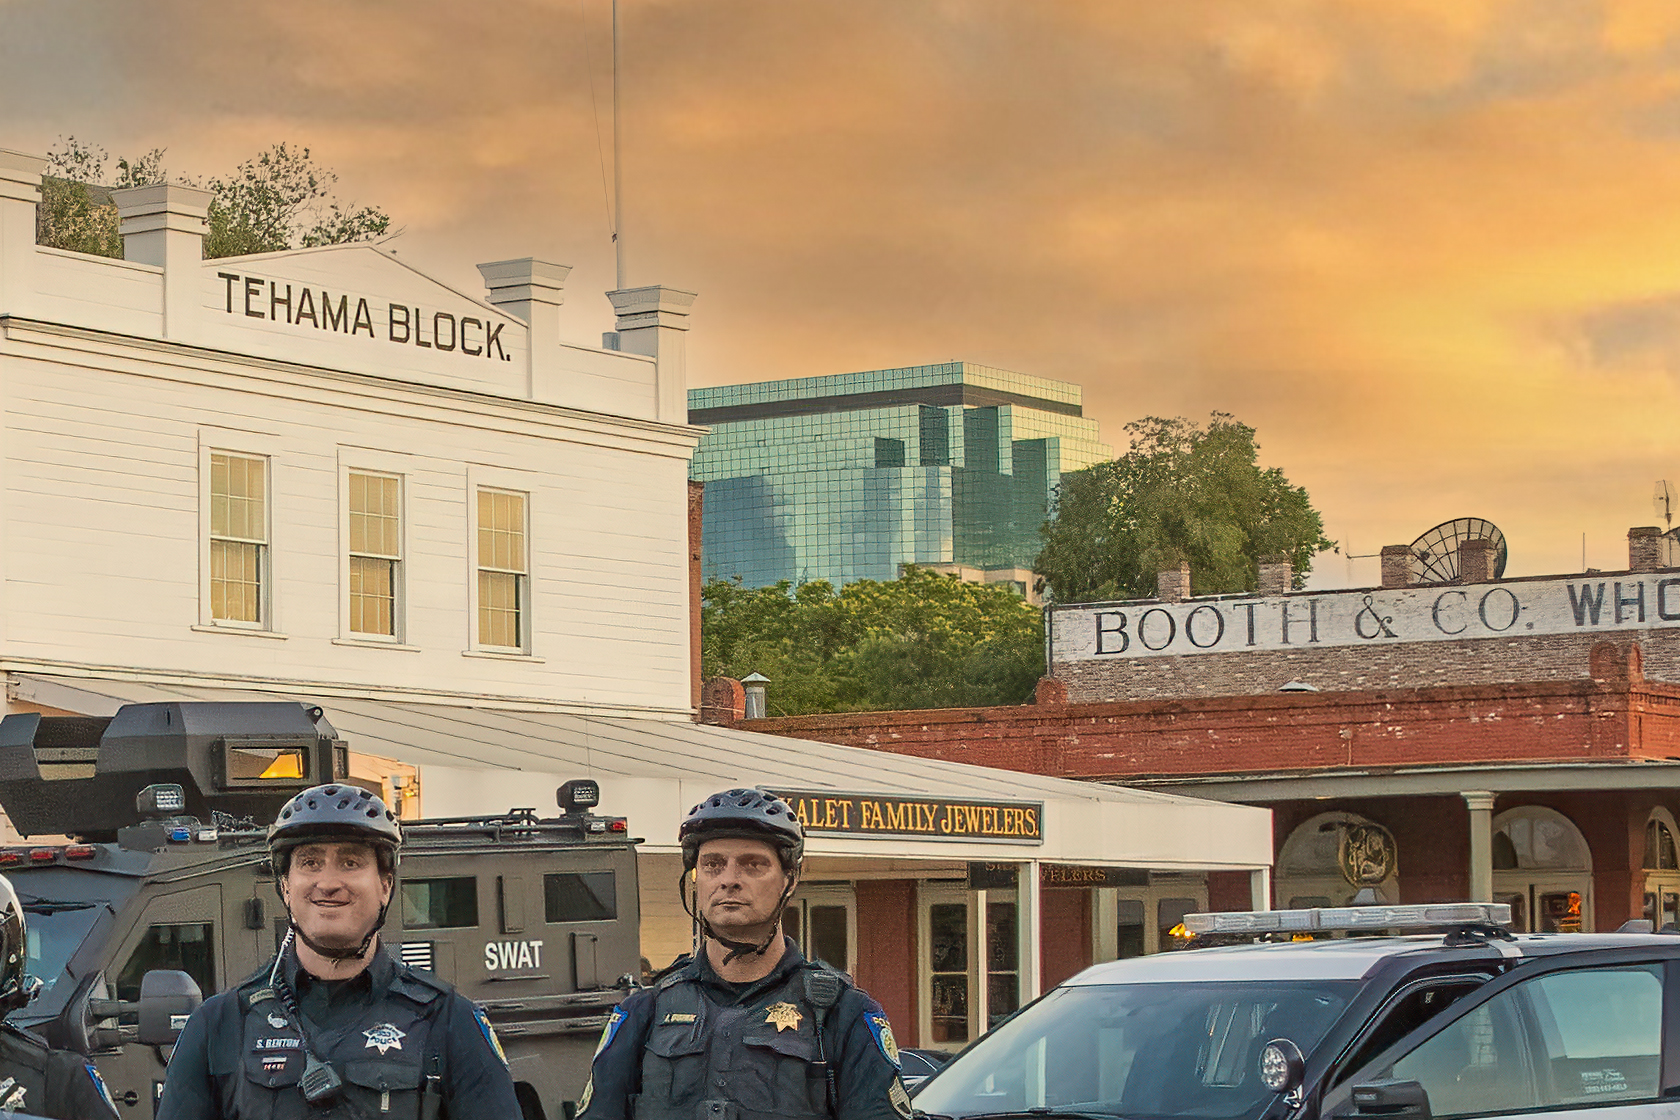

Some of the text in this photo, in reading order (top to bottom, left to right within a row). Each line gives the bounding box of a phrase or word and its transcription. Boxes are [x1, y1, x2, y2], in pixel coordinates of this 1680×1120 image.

[217, 271, 511, 362] TEHAMA BLOCK.
[1093, 598, 1321, 656] BOOTH
[1354, 595, 1398, 640] &
[1431, 586, 1534, 635] CO.
[859, 801, 939, 832] FAMILY
[940, 805, 1040, 837] JEWELERS.
[485, 940, 544, 971] SWAT
